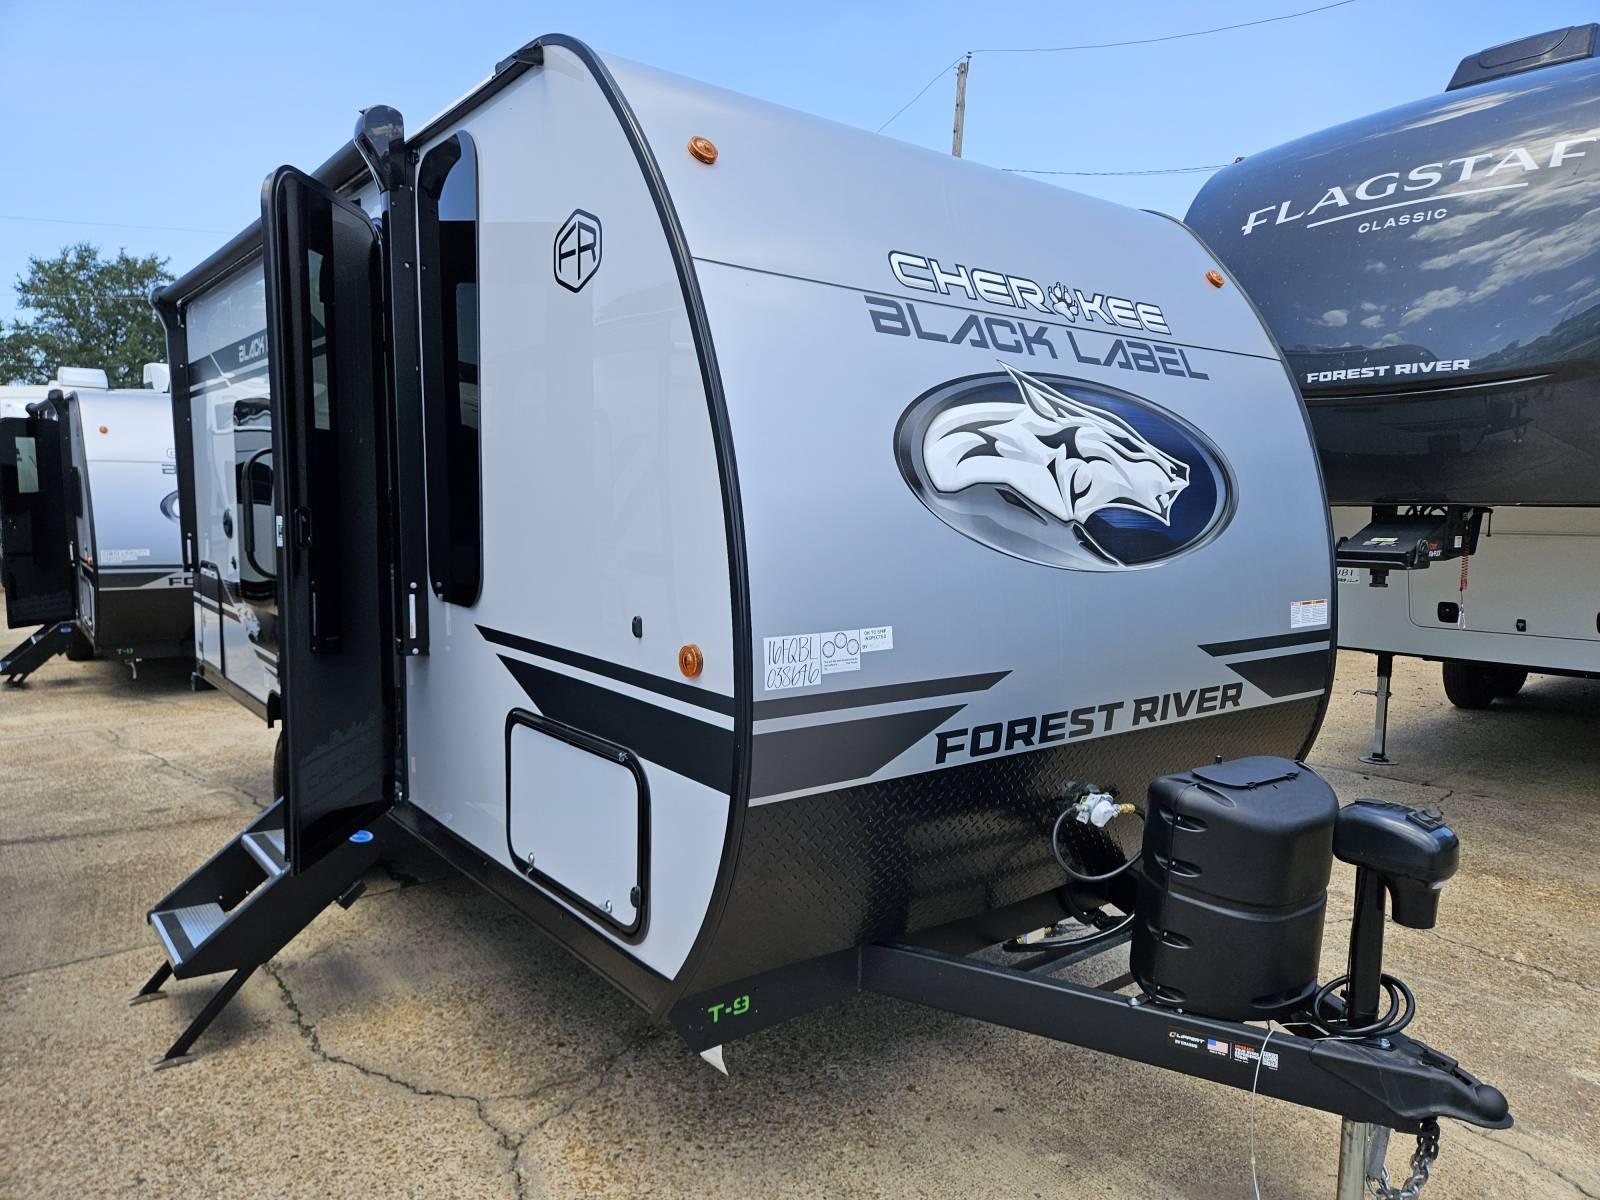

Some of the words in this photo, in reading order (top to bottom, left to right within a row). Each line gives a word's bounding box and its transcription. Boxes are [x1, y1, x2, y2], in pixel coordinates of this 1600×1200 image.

[1358, 208, 1449, 234] CLASSIC
[888, 250, 1172, 336] CHEROKEE
[238, 335, 265, 363] BLACK
[864, 295, 1058, 360] BLACK
[1065, 330, 1210, 380] LABEL
[1306, 365, 1390, 384] FOREST
[1394, 359, 1471, 375] RIVER
[768, 636, 818, 666] 16FQBL
[935, 701, 1125, 765] FOREST
[1131, 682, 1244, 726] RIVER
